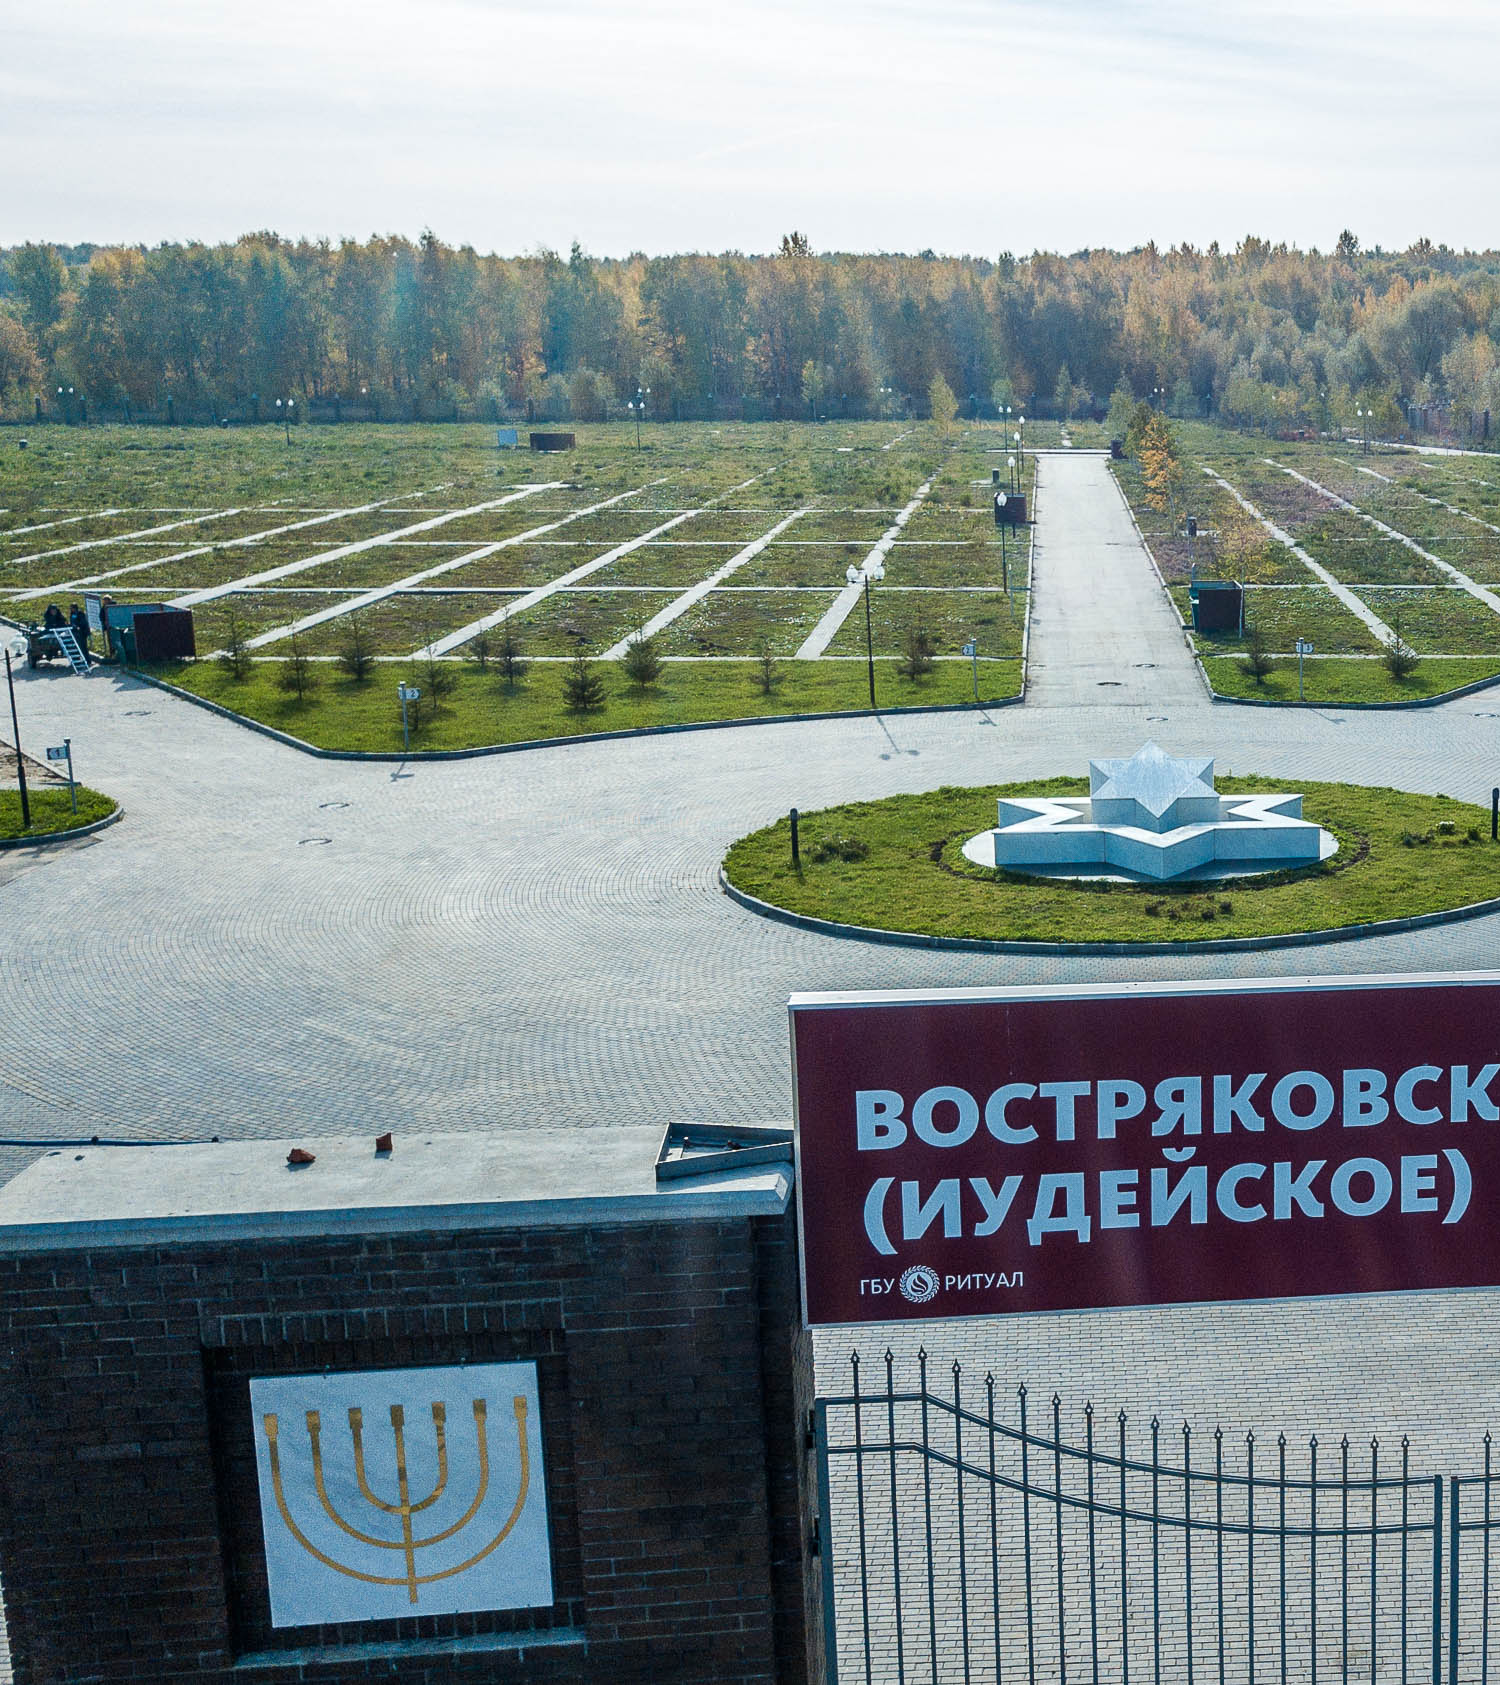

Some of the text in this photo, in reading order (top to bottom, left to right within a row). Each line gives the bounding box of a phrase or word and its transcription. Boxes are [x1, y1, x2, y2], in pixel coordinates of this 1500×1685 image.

[863, 1146, 1473, 1255] (ИУДЕЙСКОЕ)
[860, 1272, 1024, 1295] ГБУ РИТУАЛ
